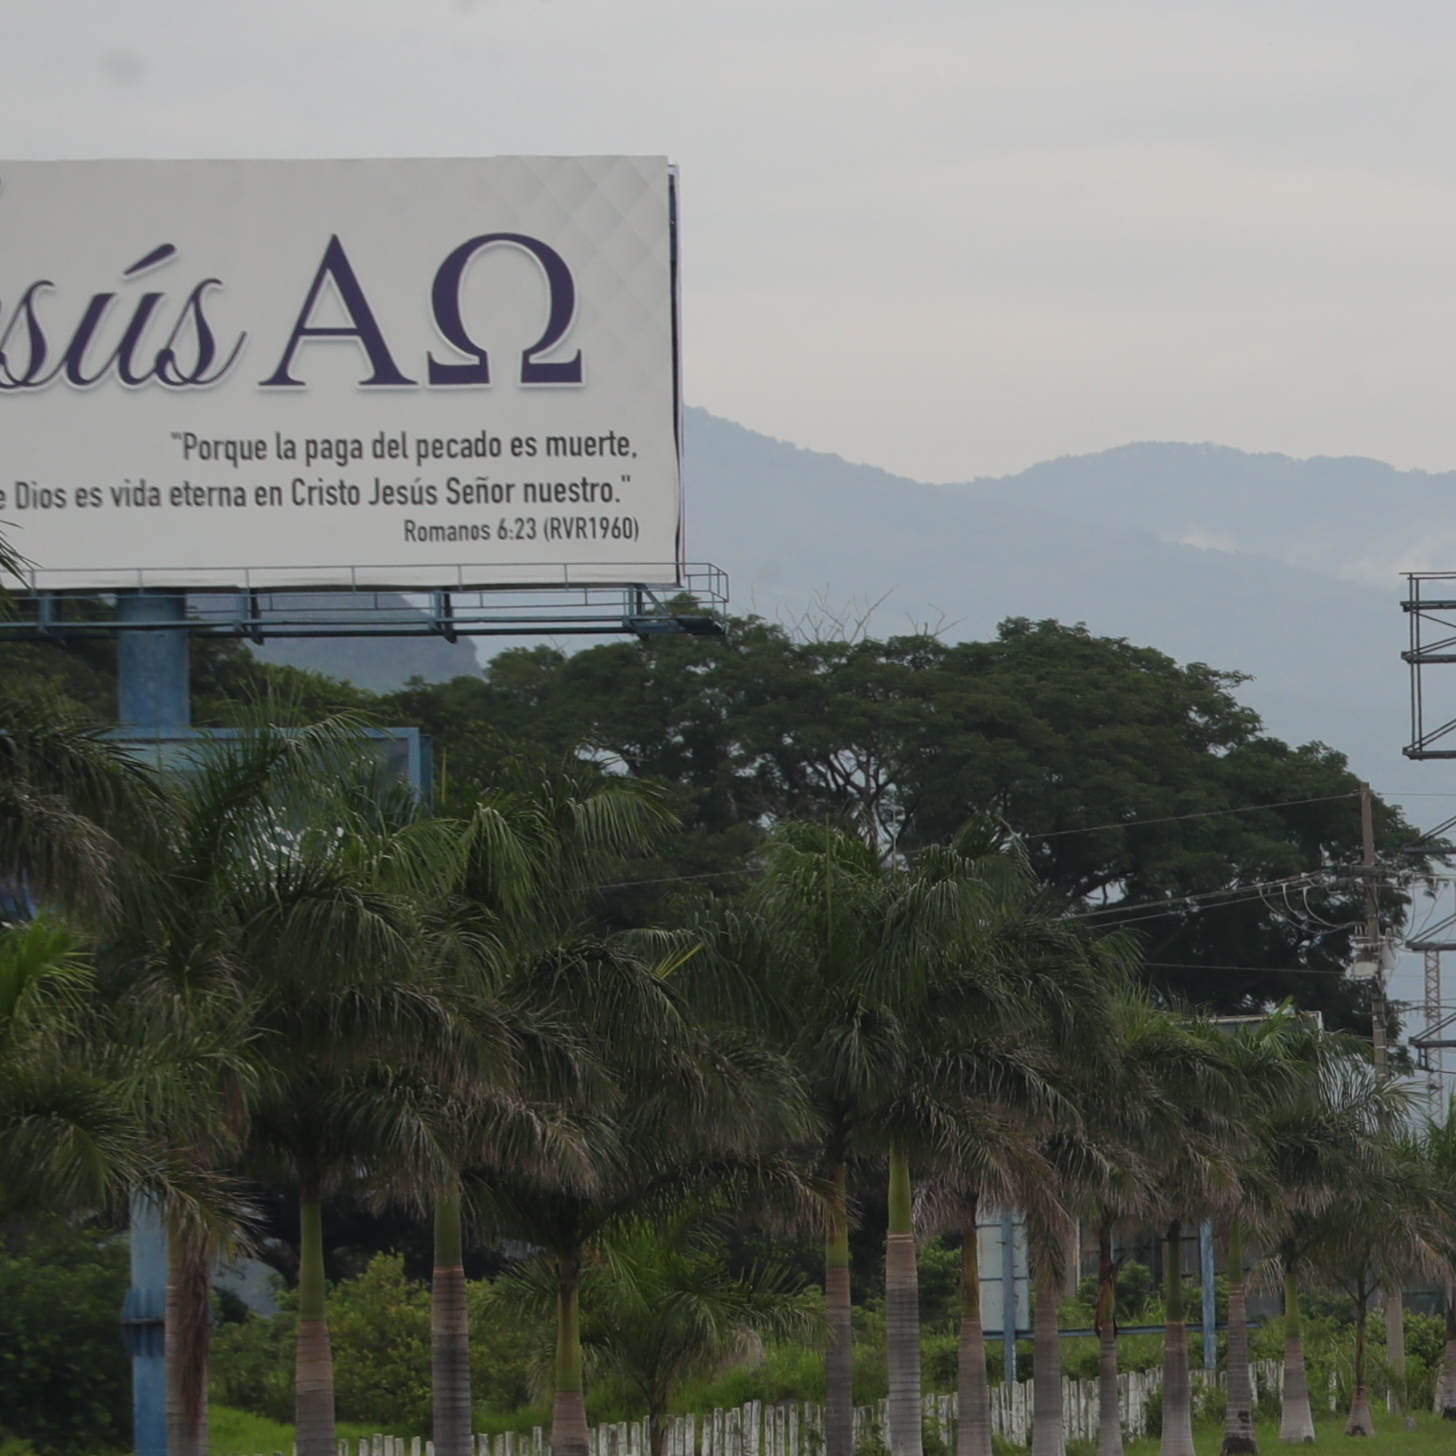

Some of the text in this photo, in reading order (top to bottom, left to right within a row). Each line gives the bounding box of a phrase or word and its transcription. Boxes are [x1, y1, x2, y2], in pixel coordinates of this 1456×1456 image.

[276, 431, 297, 461] la
[305, 438, 364, 468] paga
[372, 430, 409, 460] del
[416, 429, 502, 467] pecado
[510, 436, 538, 458] es
[546, 430, 638, 459] muerte,
[14, 480, 67, 510] Dios
[75, 486, 103, 509] es
[109, 478, 162, 508] vida
[169, 480, 247, 508] eterna
[254, 485, 283, 507] en
[291, 477, 361, 507] Cristo
[367, 477, 439, 506] Jesús
[446, 476, 516, 506] Señor
[523, 474, 631, 504] nuestro."
[404, 516, 640, 543] Romanos 6:23 (RVR1960)
